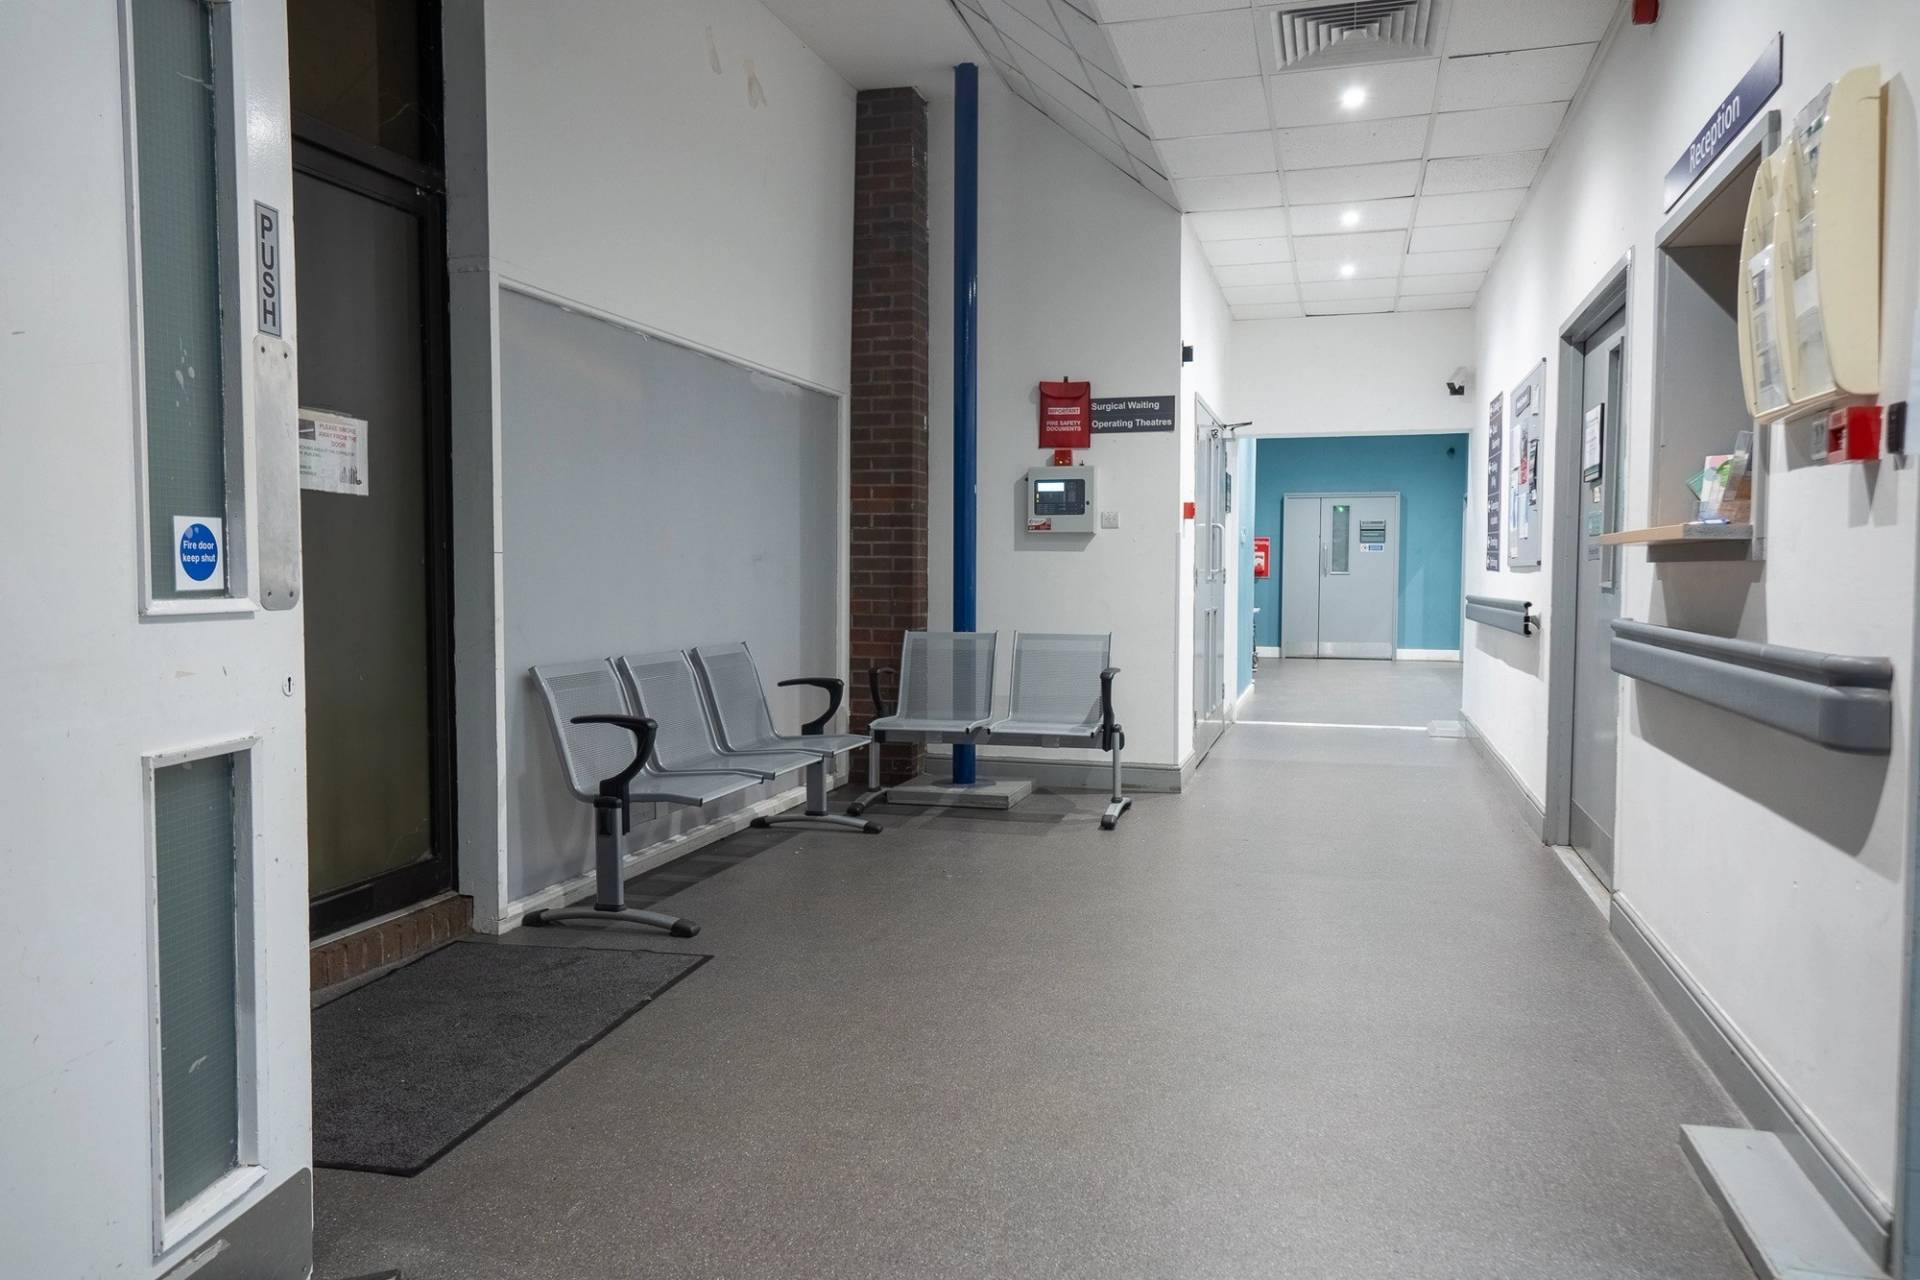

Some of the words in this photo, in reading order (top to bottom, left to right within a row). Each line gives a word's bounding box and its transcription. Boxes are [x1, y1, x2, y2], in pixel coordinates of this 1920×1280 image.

[1689, 95, 1740, 173] Reception
[261, 213, 276, 327] PUSH
[1048, 407, 1080, 415] IMPORTANT
[1091, 401, 1126, 412] Surgical
[1127, 401, 1160, 410] Waiting
[1091, 420, 1133, 429] Operating
[1135, 418, 1172, 427] Theatres
[182, 540, 197, 549] Fire
[198, 540, 215, 549] door
[182, 553, 200, 564] keep
[201, 553, 216, 563] shut
